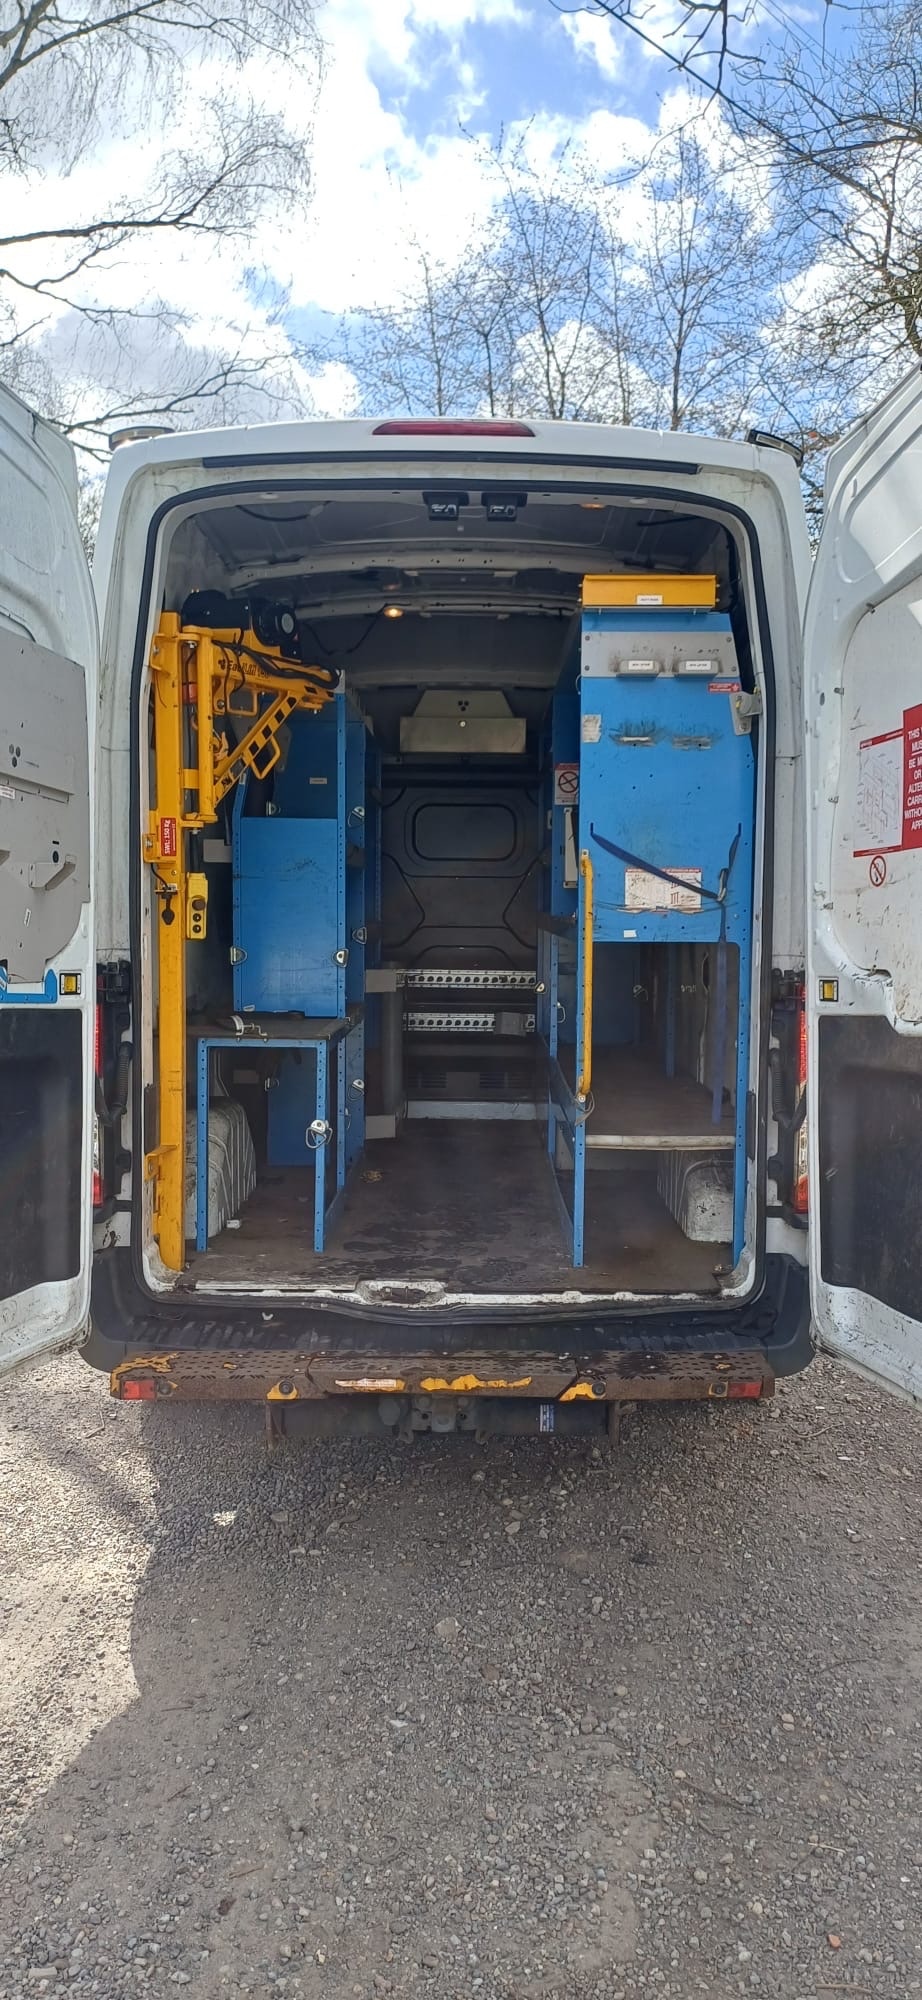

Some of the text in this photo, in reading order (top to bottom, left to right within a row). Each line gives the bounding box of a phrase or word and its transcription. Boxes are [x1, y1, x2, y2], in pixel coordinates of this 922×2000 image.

[908, 728, 920, 740] THIS
[908, 758, 916, 769] BE
[914, 769, 922, 780] OR
